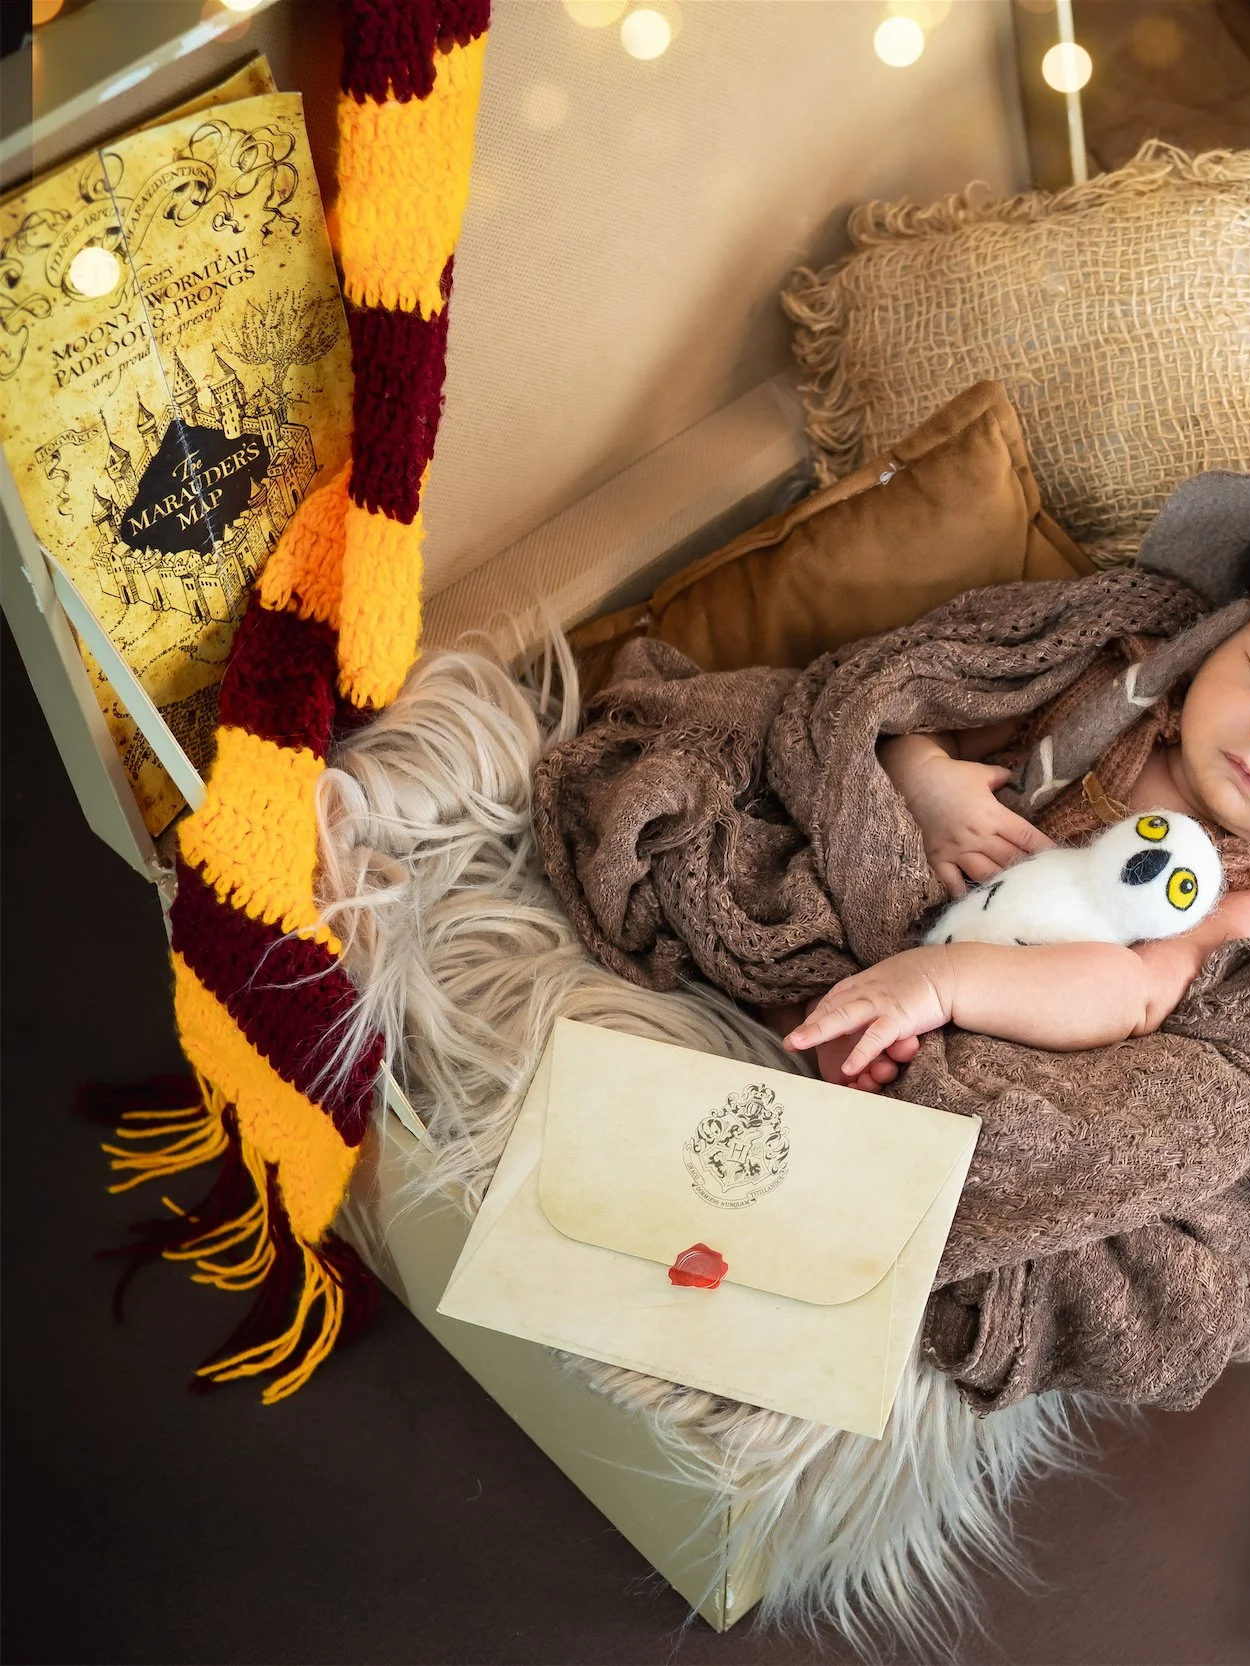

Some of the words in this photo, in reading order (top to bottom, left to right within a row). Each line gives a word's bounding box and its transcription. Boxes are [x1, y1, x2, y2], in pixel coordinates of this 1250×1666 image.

[54, 321, 148, 388] PADFOOT
[151, 307, 165, 329] &
[173, 264, 256, 316] PRONGS
[92, 371, 113, 388] are
[109, 344, 151, 396] proud
[160, 328, 172, 345] to
[177, 297, 223, 347] present
[39, 427, 99, 458] HOGWARTS
[127, 442, 260, 536] MARAUDER'S
[176, 488, 223, 530] MAP
